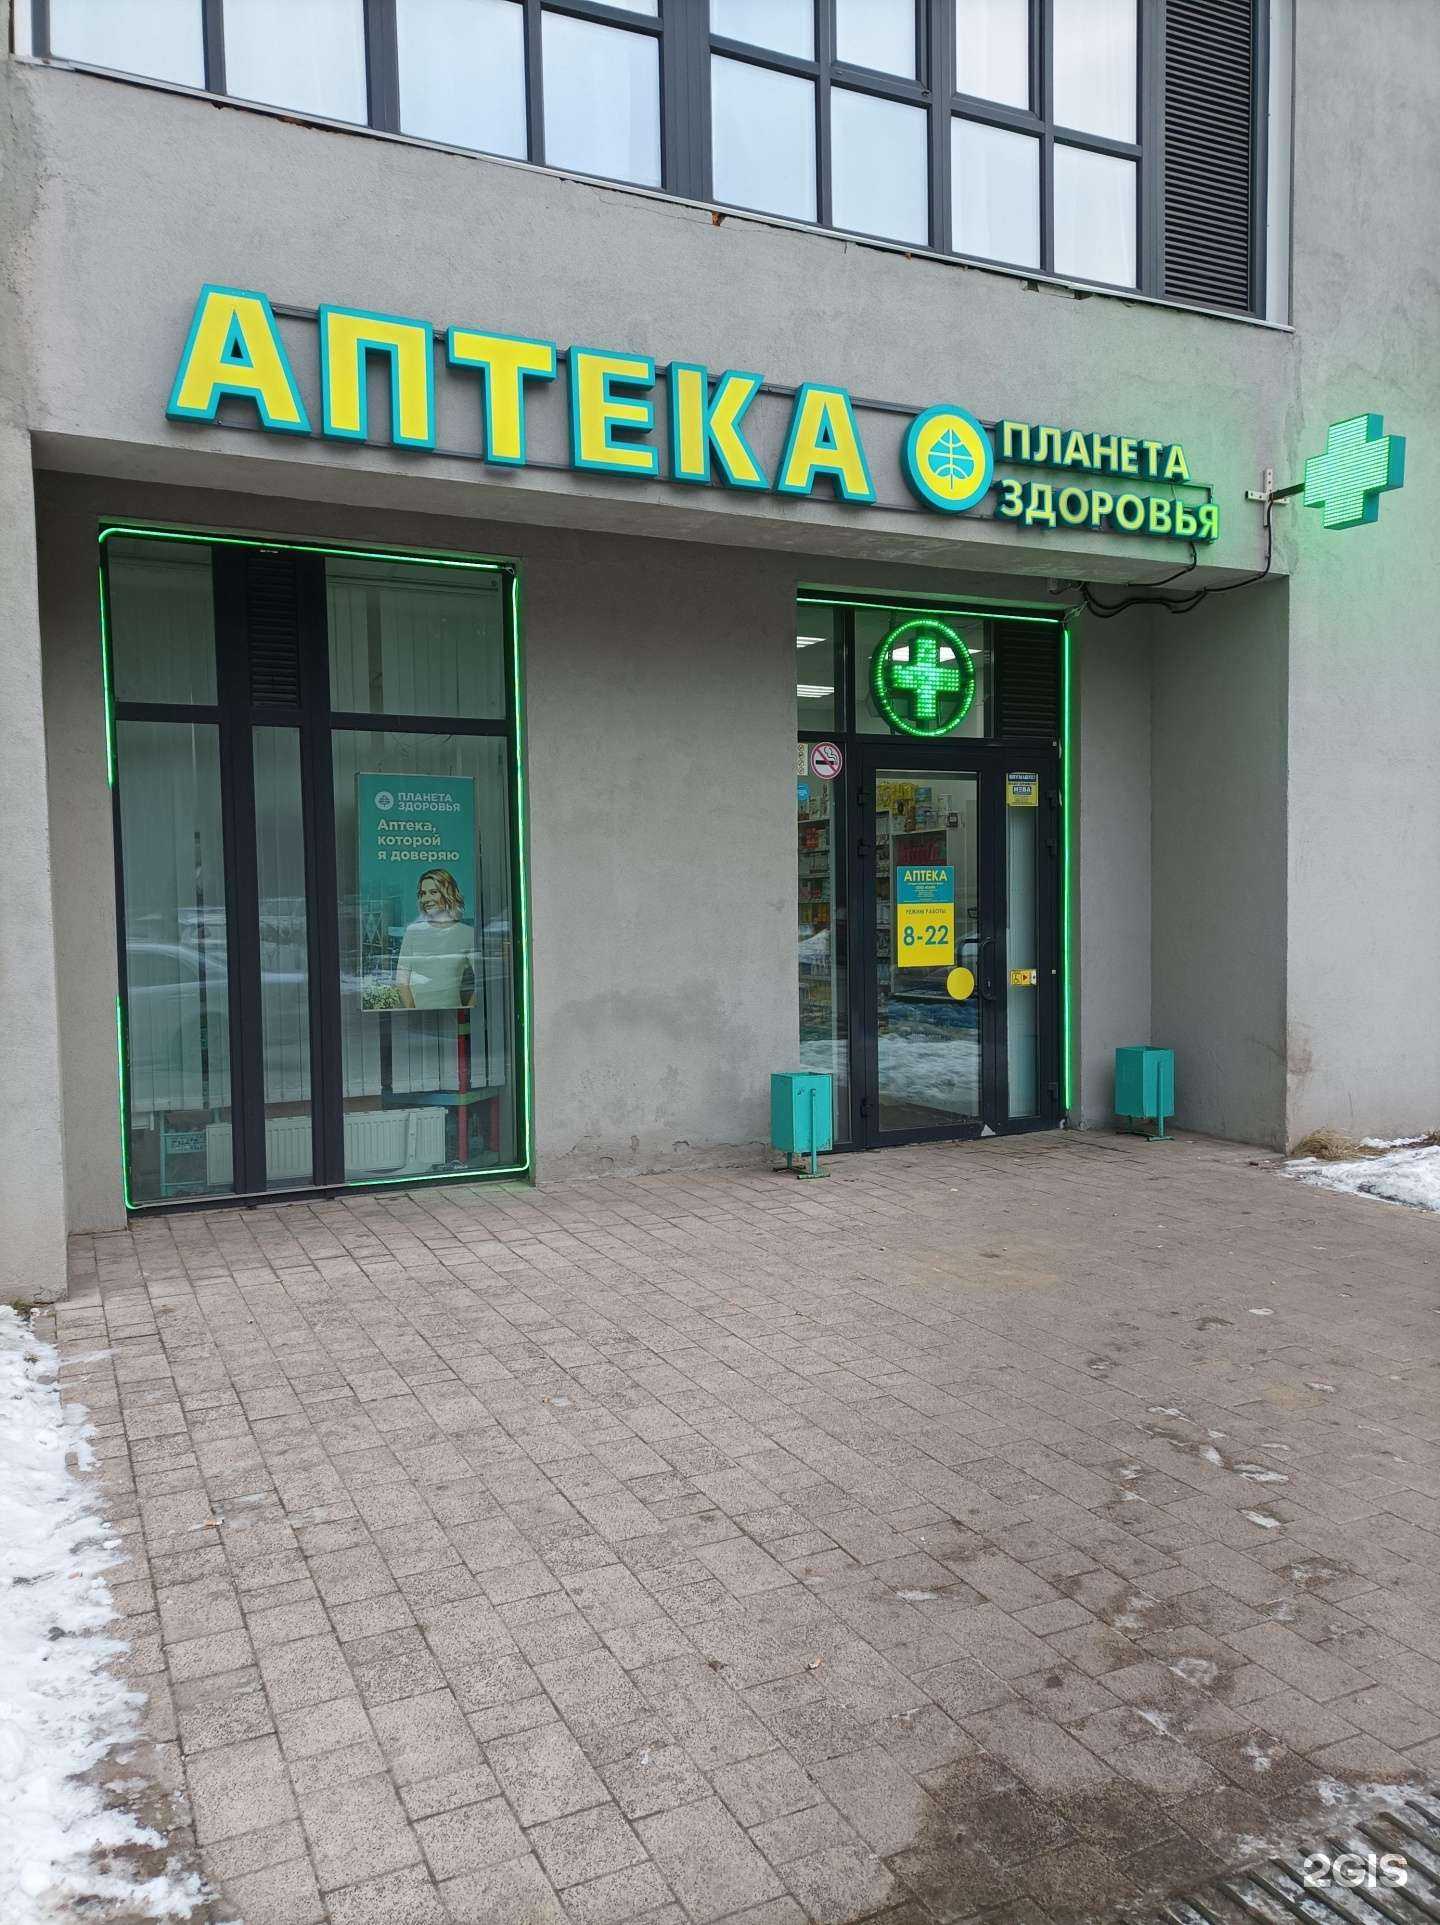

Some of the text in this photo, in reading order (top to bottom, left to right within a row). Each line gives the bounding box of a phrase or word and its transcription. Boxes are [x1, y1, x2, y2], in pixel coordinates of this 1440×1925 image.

[166, 284, 877, 504] АПТЕКА
[999, 420, 1191, 483] ПЛАНЕТА
[999, 478, 1220, 542] ЗДОРОВЬЯ
[398, 792, 453, 802] ПЛАНЕТА
[398, 801, 461, 812] ЗДОРОВЬЯ
[377, 819, 437, 833] Аптека,
[377, 833, 441, 848] которой
[377, 851, 460, 862] я доверяю
[903, 870, 948, 882] АПТЕКА
[903, 925, 949, 946] 8-22
